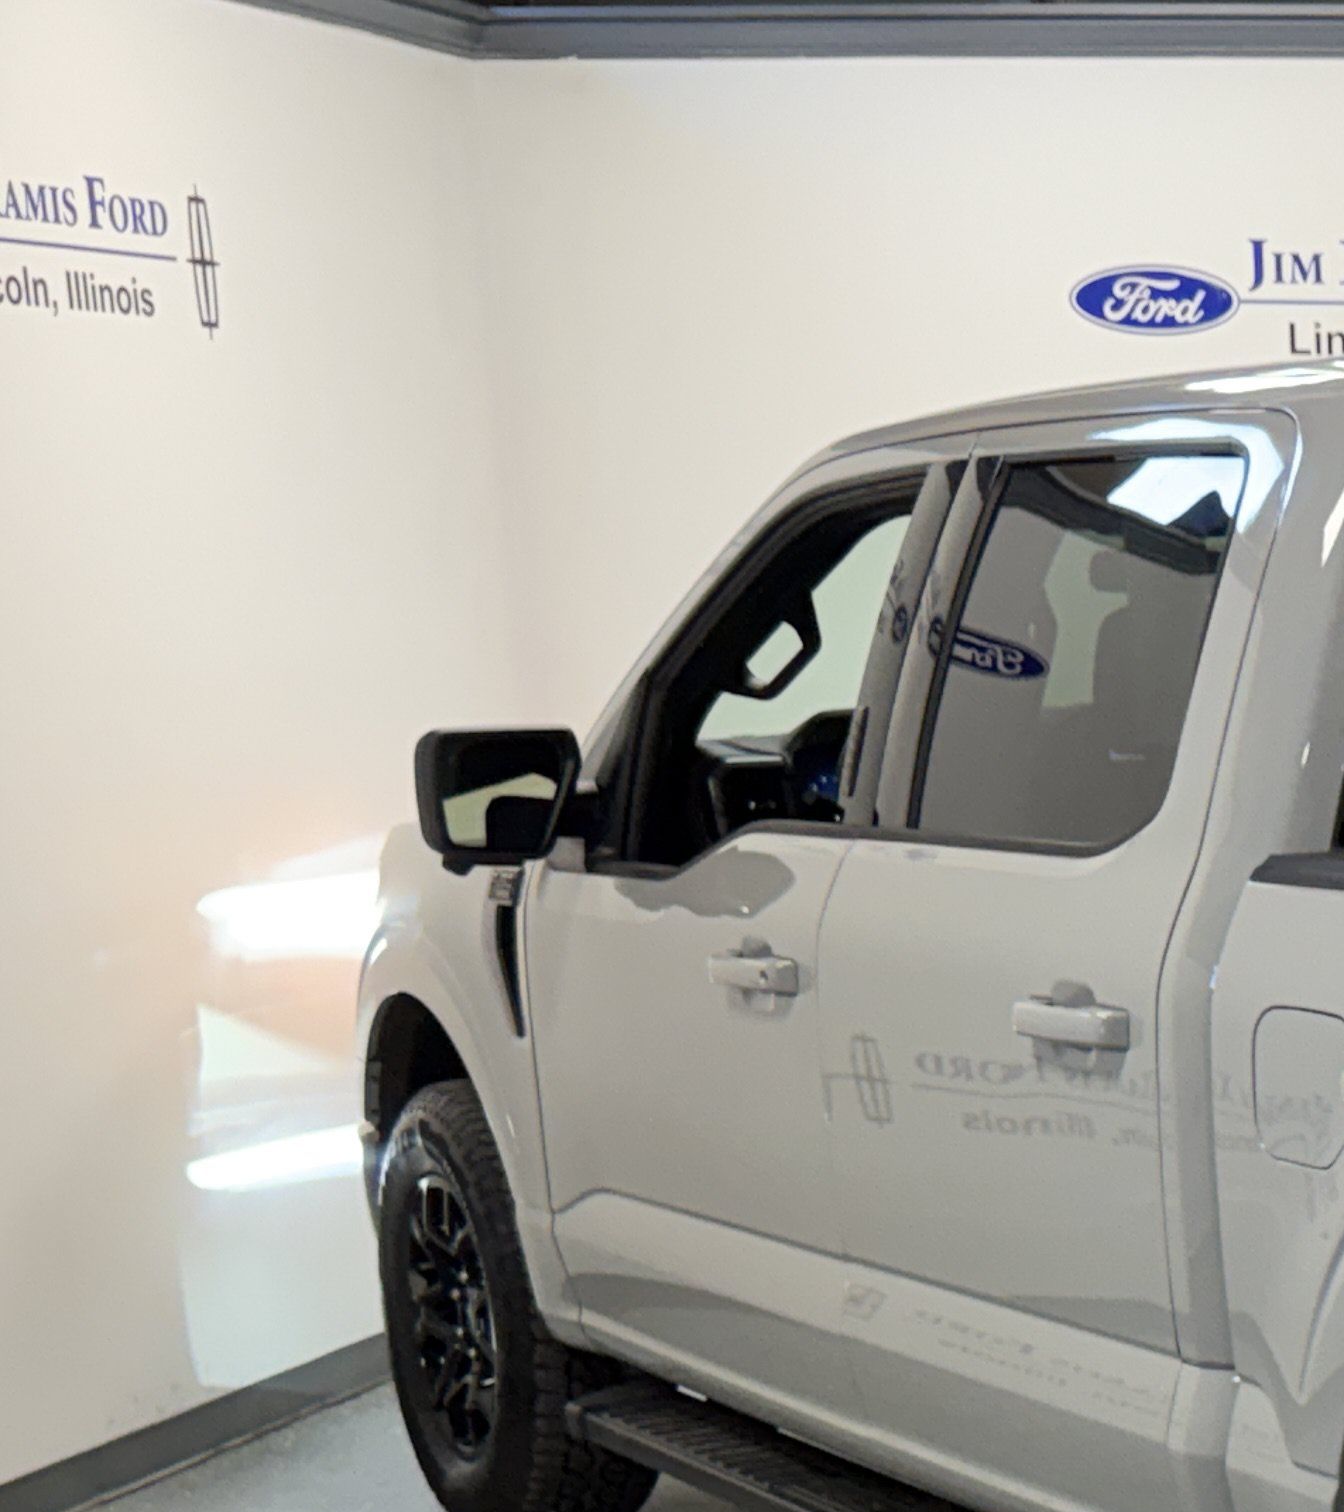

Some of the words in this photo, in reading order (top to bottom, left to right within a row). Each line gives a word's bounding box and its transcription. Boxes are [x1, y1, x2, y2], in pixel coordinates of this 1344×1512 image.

[0, 180, 78, 228] AMIS
[82, 175, 168, 237] FORD
[1247, 239, 1323, 292] JIM
[65, 270, 156, 317] Illinois
[1102, 275, 1207, 324] Ford
